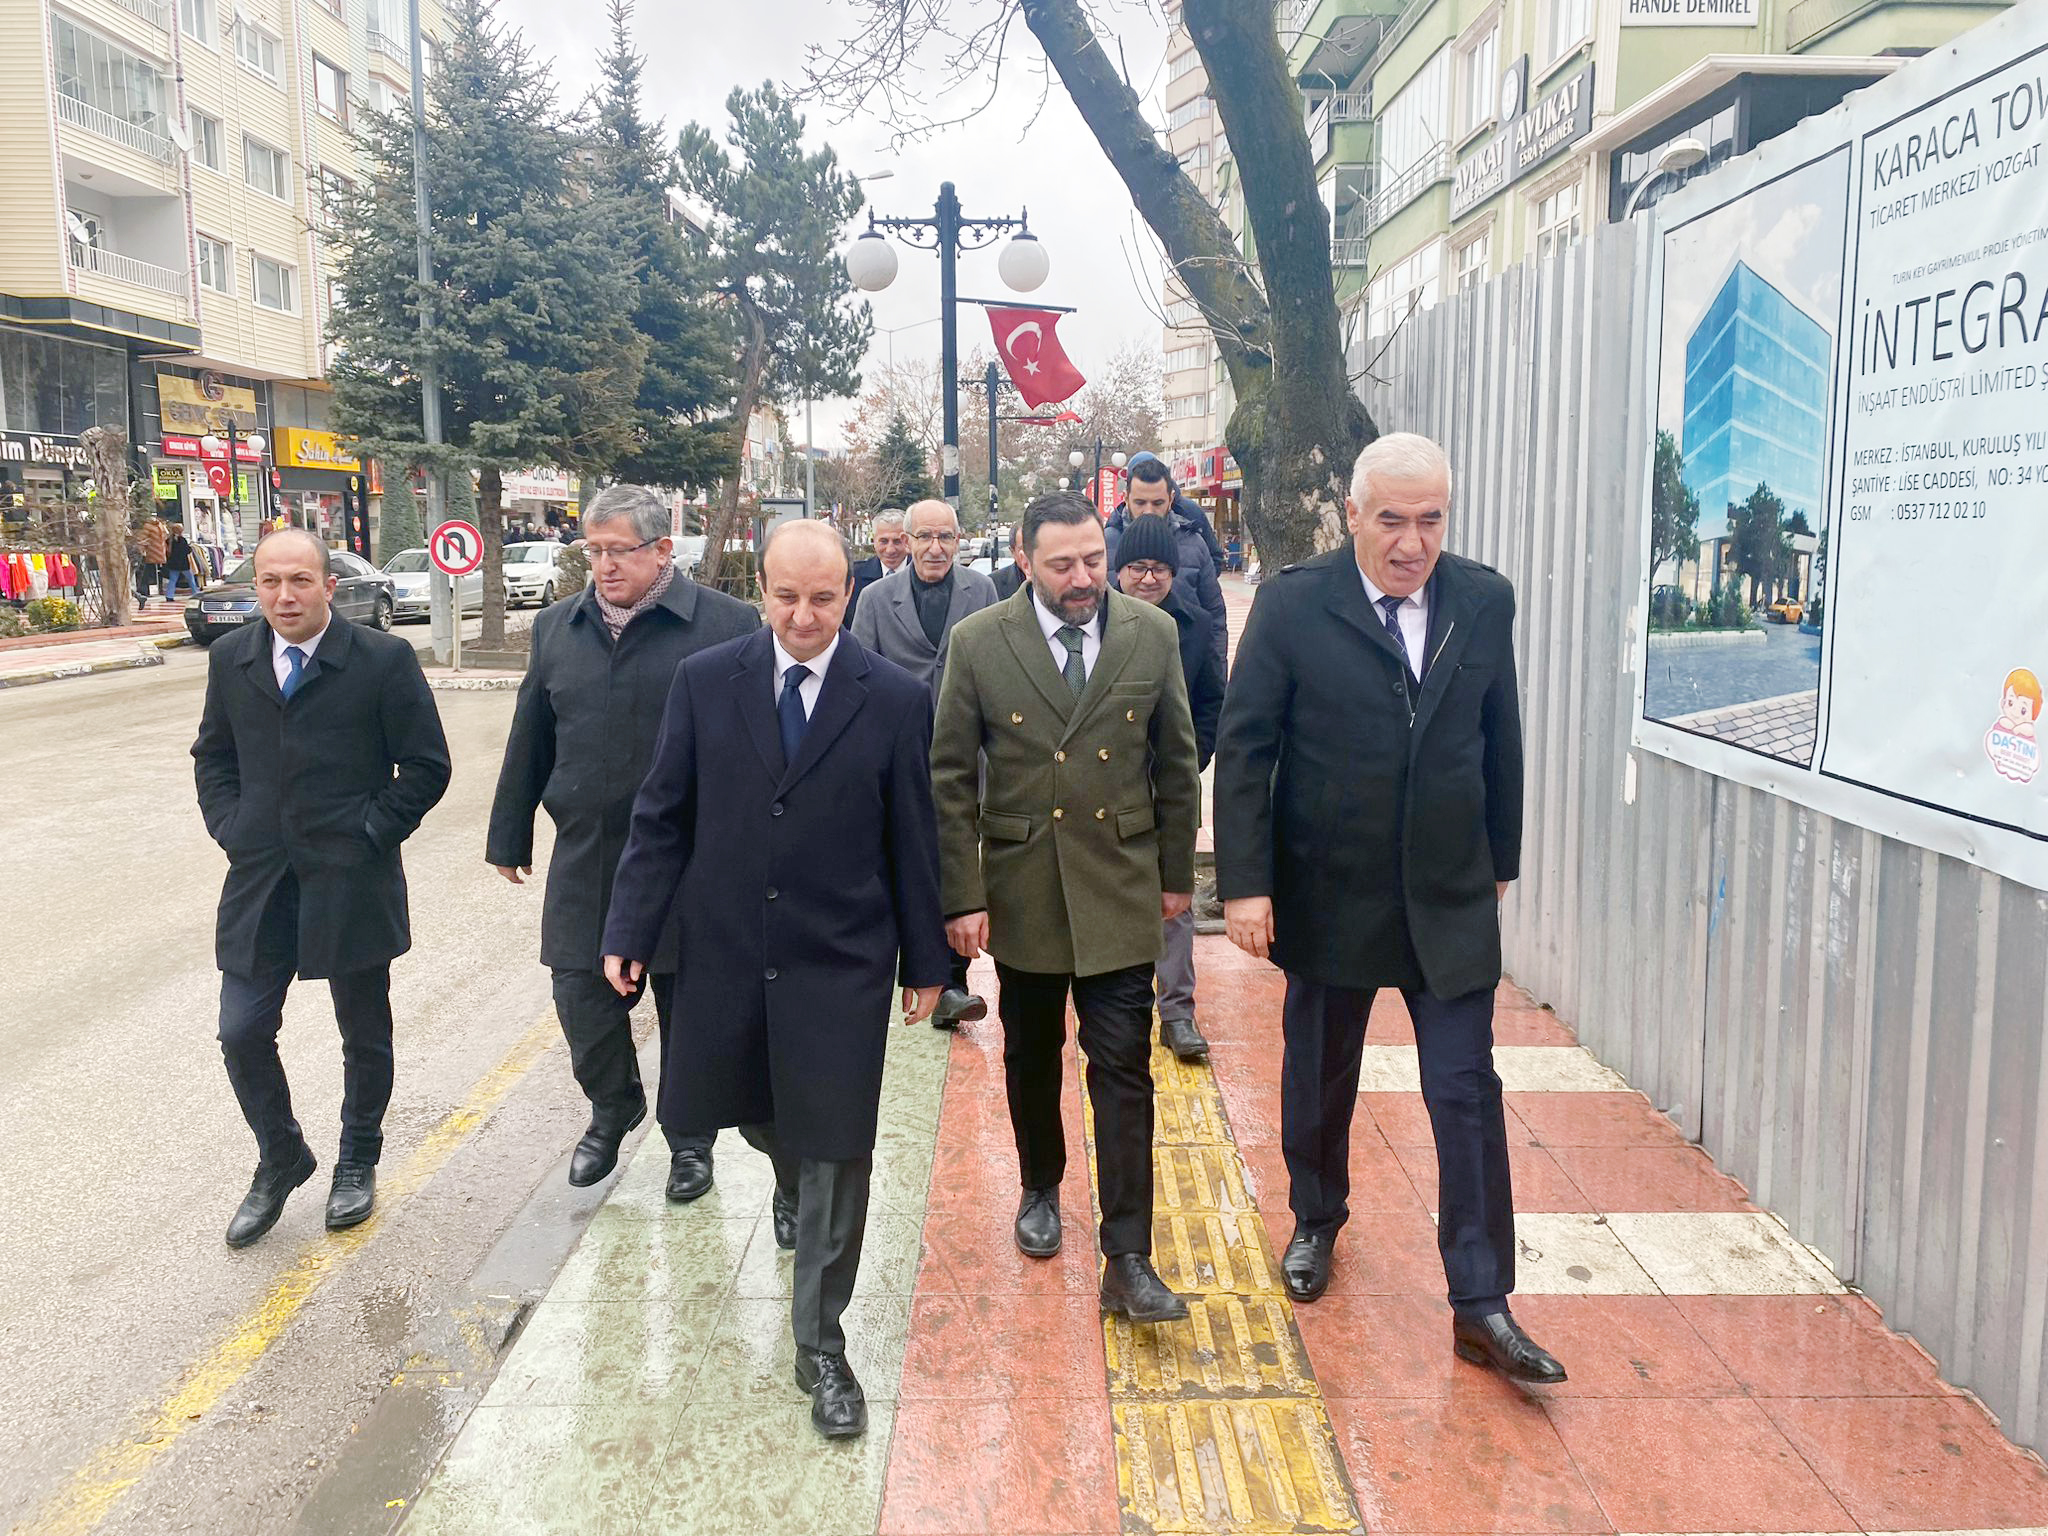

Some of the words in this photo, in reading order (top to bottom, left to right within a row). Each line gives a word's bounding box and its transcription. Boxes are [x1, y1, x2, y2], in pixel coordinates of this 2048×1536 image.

[1629, 0, 1680, 13] HANDE
[1515, 74, 1583, 153] AVUKAT
[1454, 135, 1507, 197] AVUKAT
[1519, 144, 1539, 168] ESRA
[1873, 107, 1980, 191] KARACA
[1869, 194, 1919, 229] TİCARET
[1920, 164, 1981, 211] MERKEZİ
[1984, 143, 2042, 185] YOZGAT
[1892, 272, 1912, 286] TURN
[1912, 266, 1927, 280] KEY
[1927, 248, 1982, 276] GAYRİMENKUL
[1983, 239, 2010, 259] PROJE
[1857, 388, 1899, 417] İNŞAAT
[1901, 371, 1966, 407] ENDÜSTRİ
[1970, 364, 2037, 396] LİMİTED
[0, 433, 25, 461] im
[29, 436, 92, 470] Dünya
[1853, 447, 1893, 466] MERKEZ
[1901, 442, 1959, 462] İSTANBUL,
[1962, 433, 2021, 457] KURULUŞ
[159, 470, 184, 478] OKUL
[1103, 470, 1114, 513] SERVİS
[1852, 473, 1891, 497] ŞANTİYE
[1898, 471, 1920, 491] LİSE
[1923, 466, 1979, 491] CADDESİ,
[1988, 467, 2013, 487] NO:
[2016, 466, 2032, 485] 34
[1850, 506, 1872, 521] GSM
[1897, 503, 1926, 520] 0537
[1929, 502, 1950, 520] 712
[1953, 501, 1968, 519] 02
[1972, 501, 1987, 519] 10
